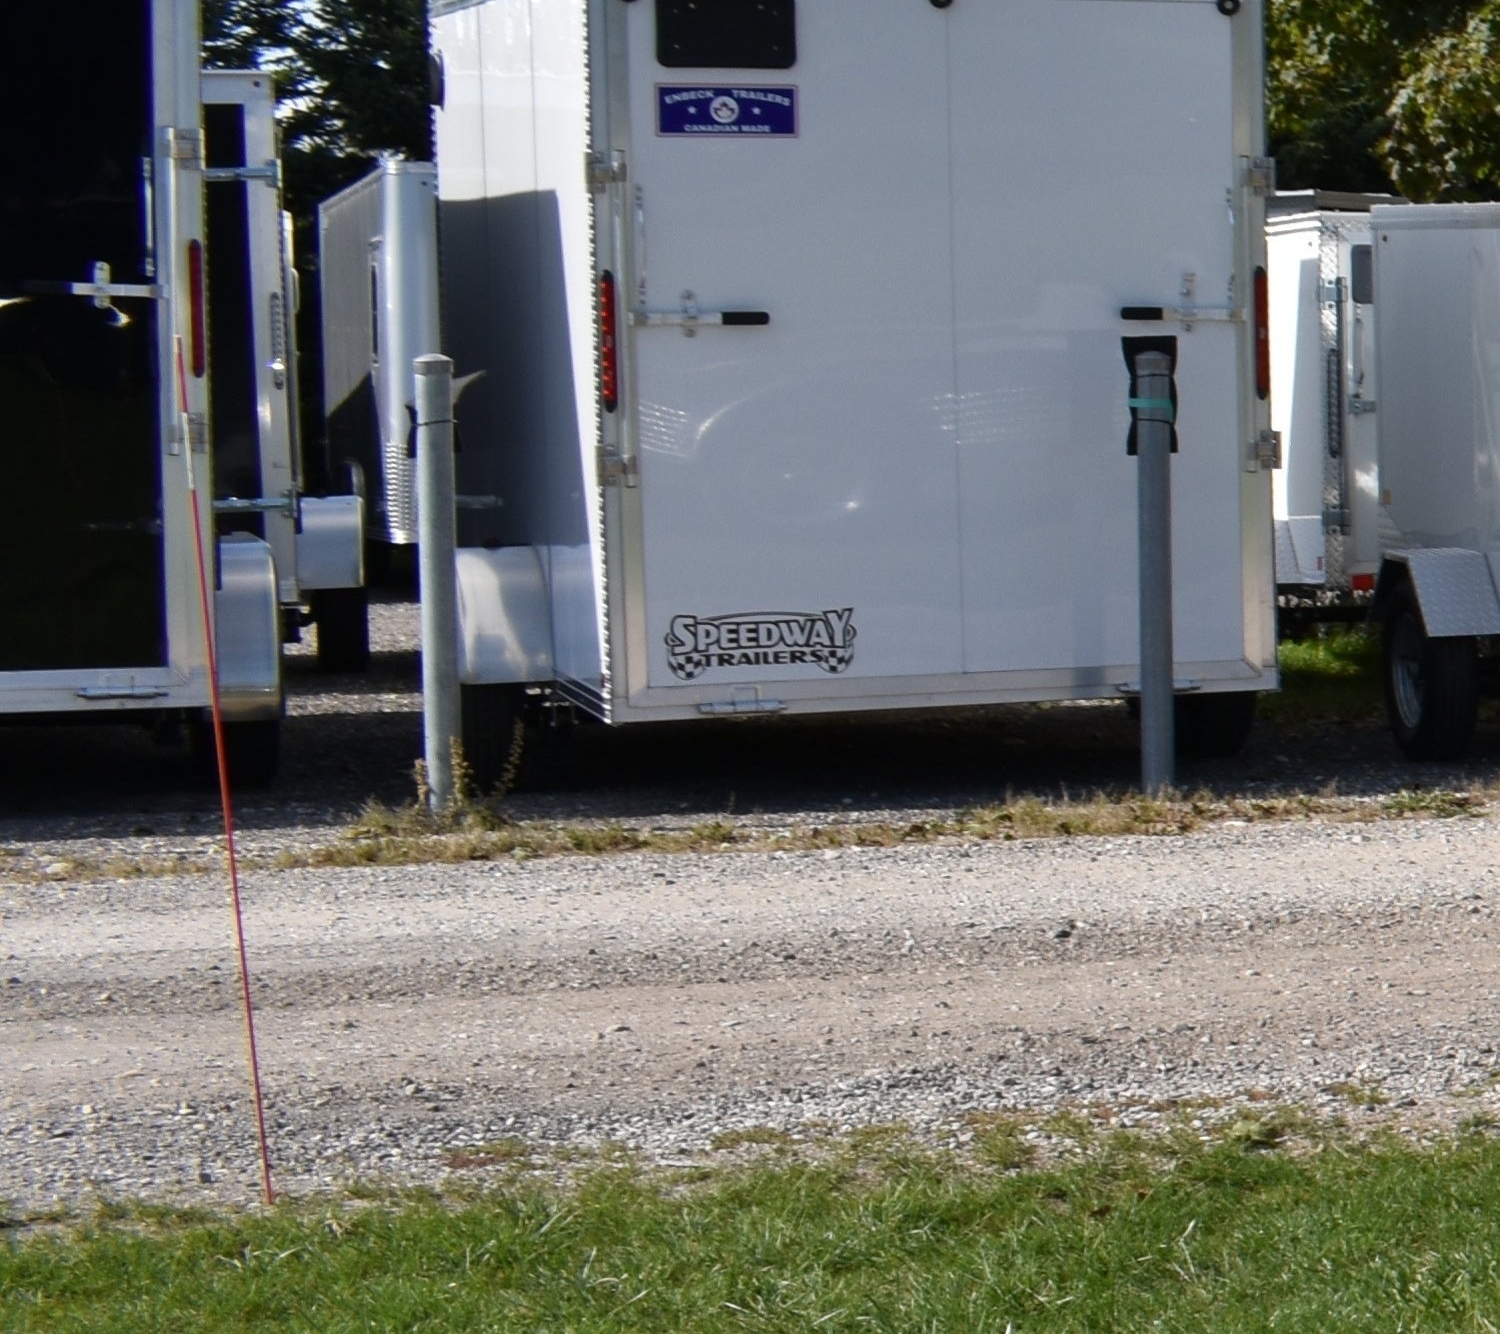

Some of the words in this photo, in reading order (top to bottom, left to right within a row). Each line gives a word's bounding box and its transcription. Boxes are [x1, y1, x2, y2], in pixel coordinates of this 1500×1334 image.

[664, 89, 715, 105] ENBECK
[731, 89, 791, 107] TRAILERS
[684, 124, 739, 133] CANADIAN
[741, 124, 771, 133] MADE
[671, 608, 854, 656] SPEEDWAY
[703, 650, 824, 668] TRAILERS
